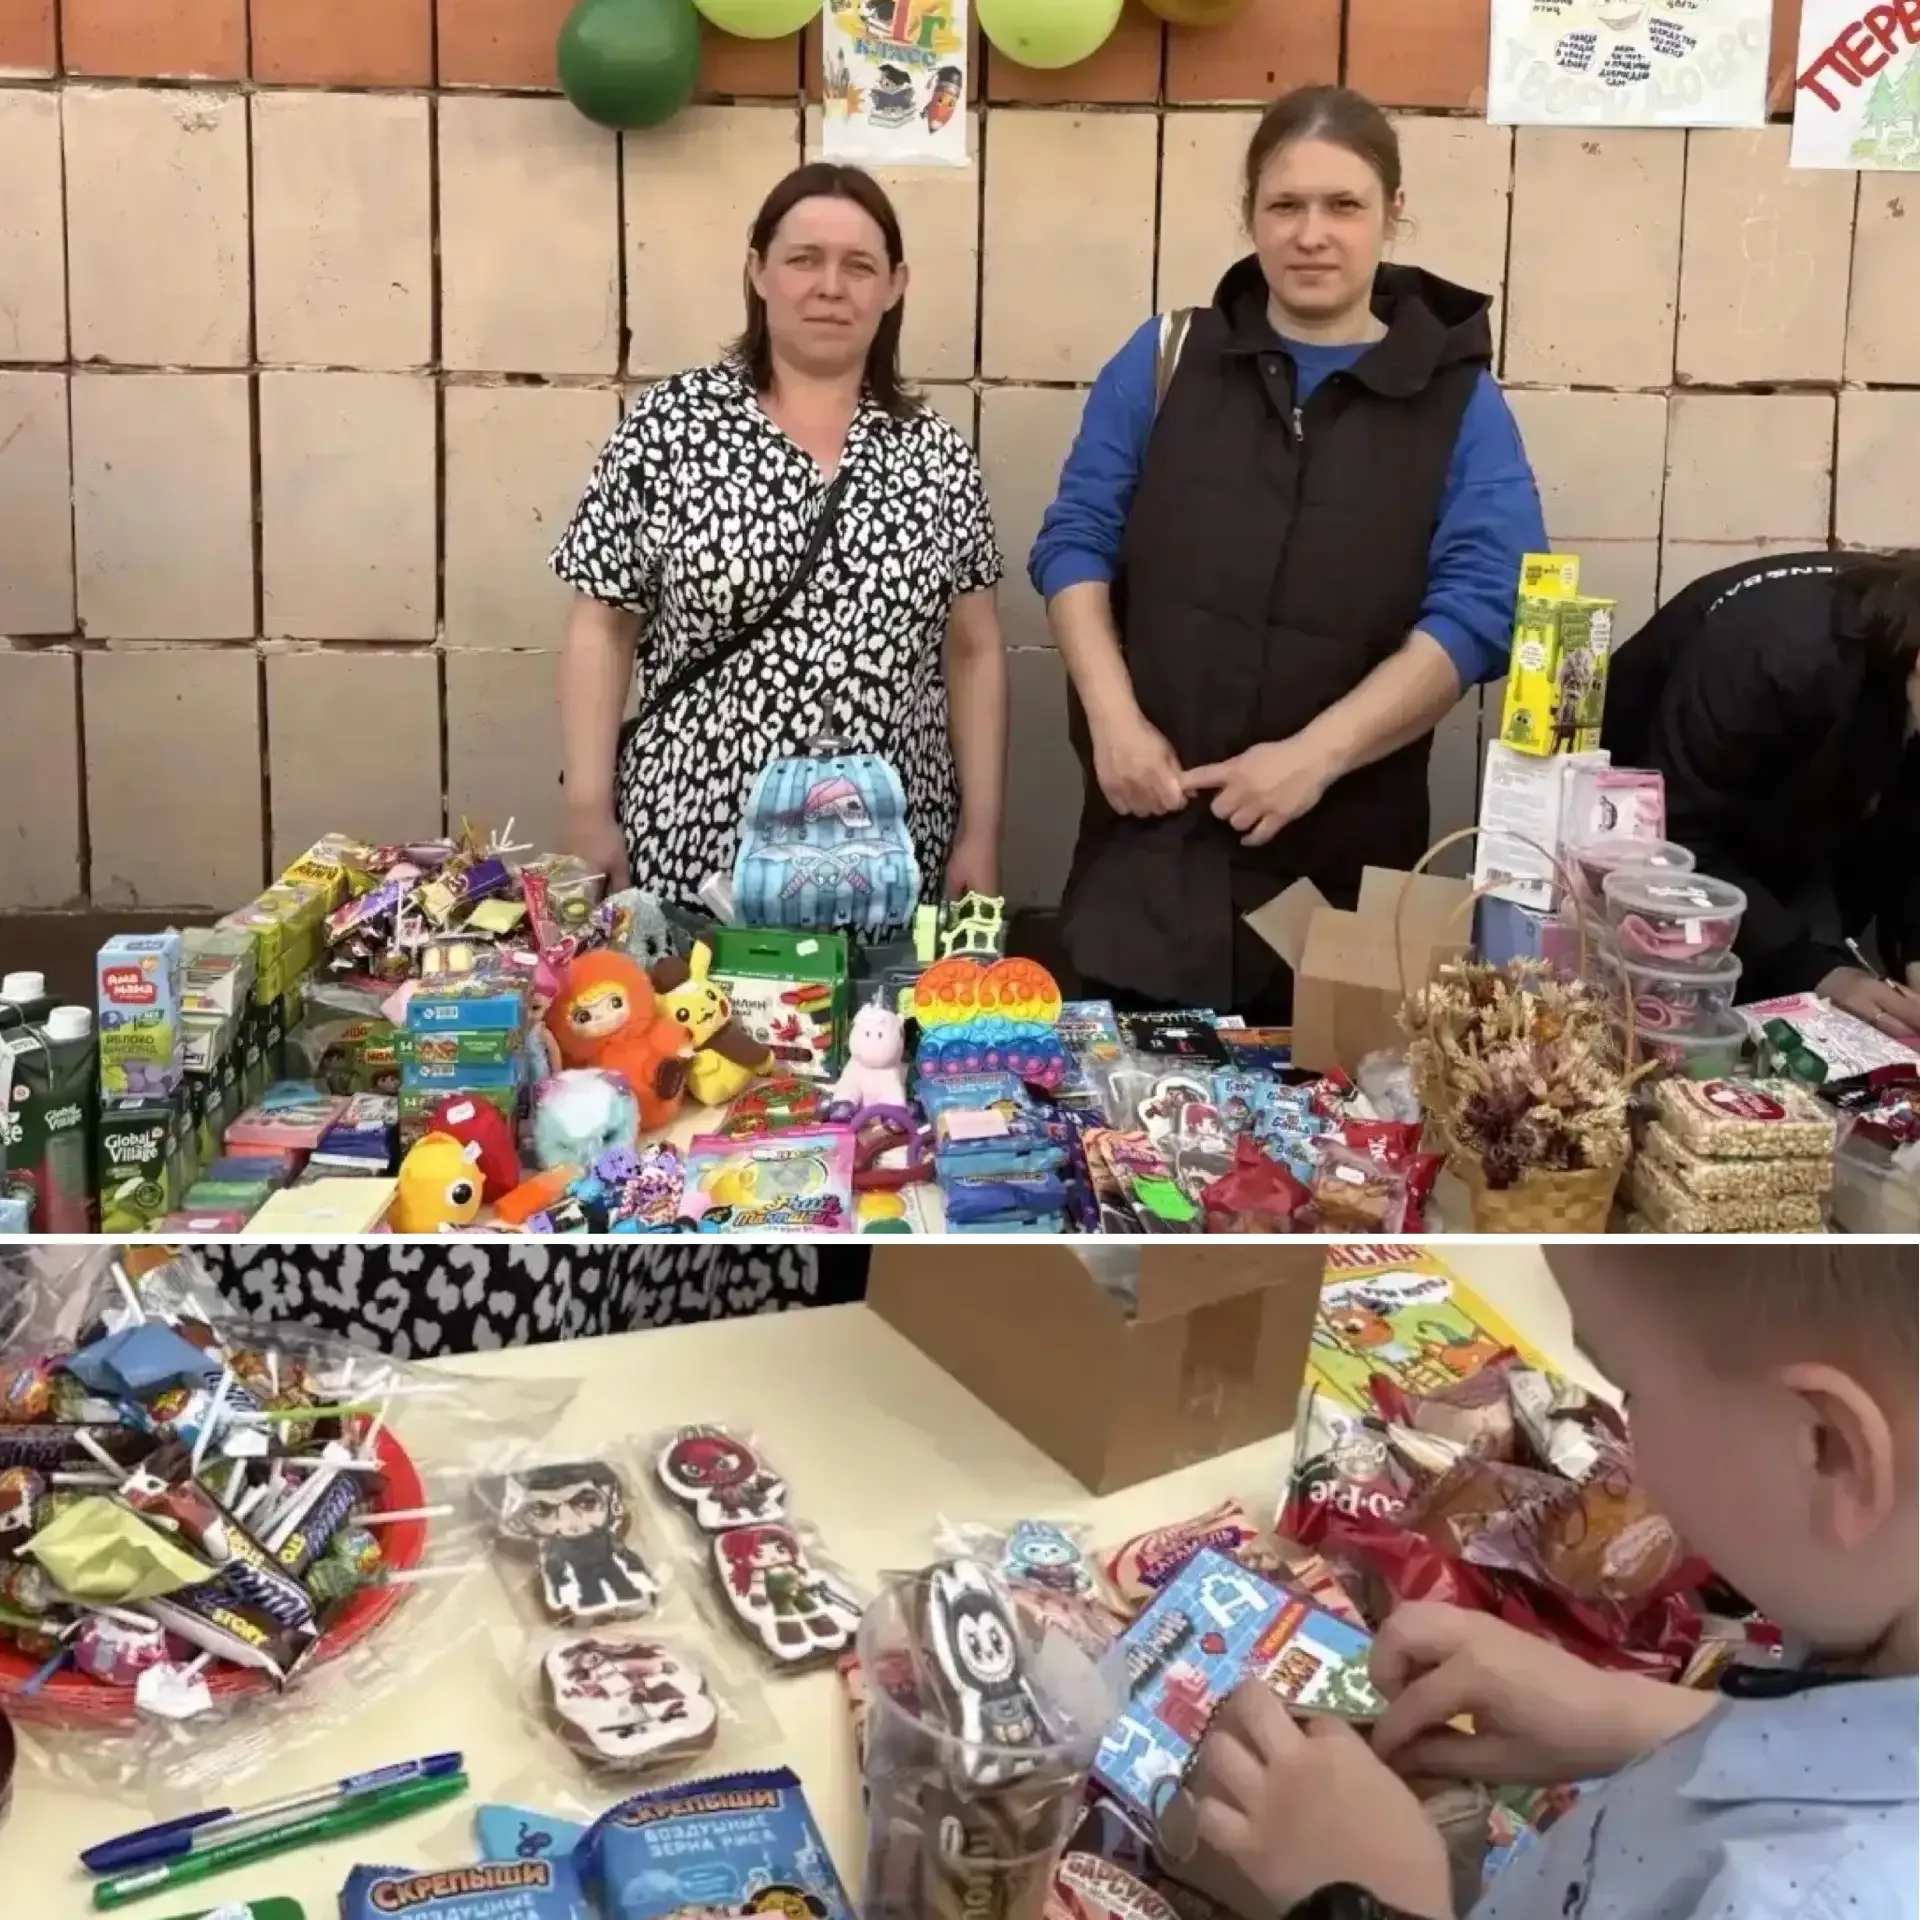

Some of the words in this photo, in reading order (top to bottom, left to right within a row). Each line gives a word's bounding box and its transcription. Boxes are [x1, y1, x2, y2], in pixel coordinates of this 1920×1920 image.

[106, 1034, 154, 1045] ЯБЛОКО
[104, 1131, 150, 1148] Global
[109, 1146, 158, 1162] Village
[372, 1862, 548, 1912] СКРЕПЫШИ
